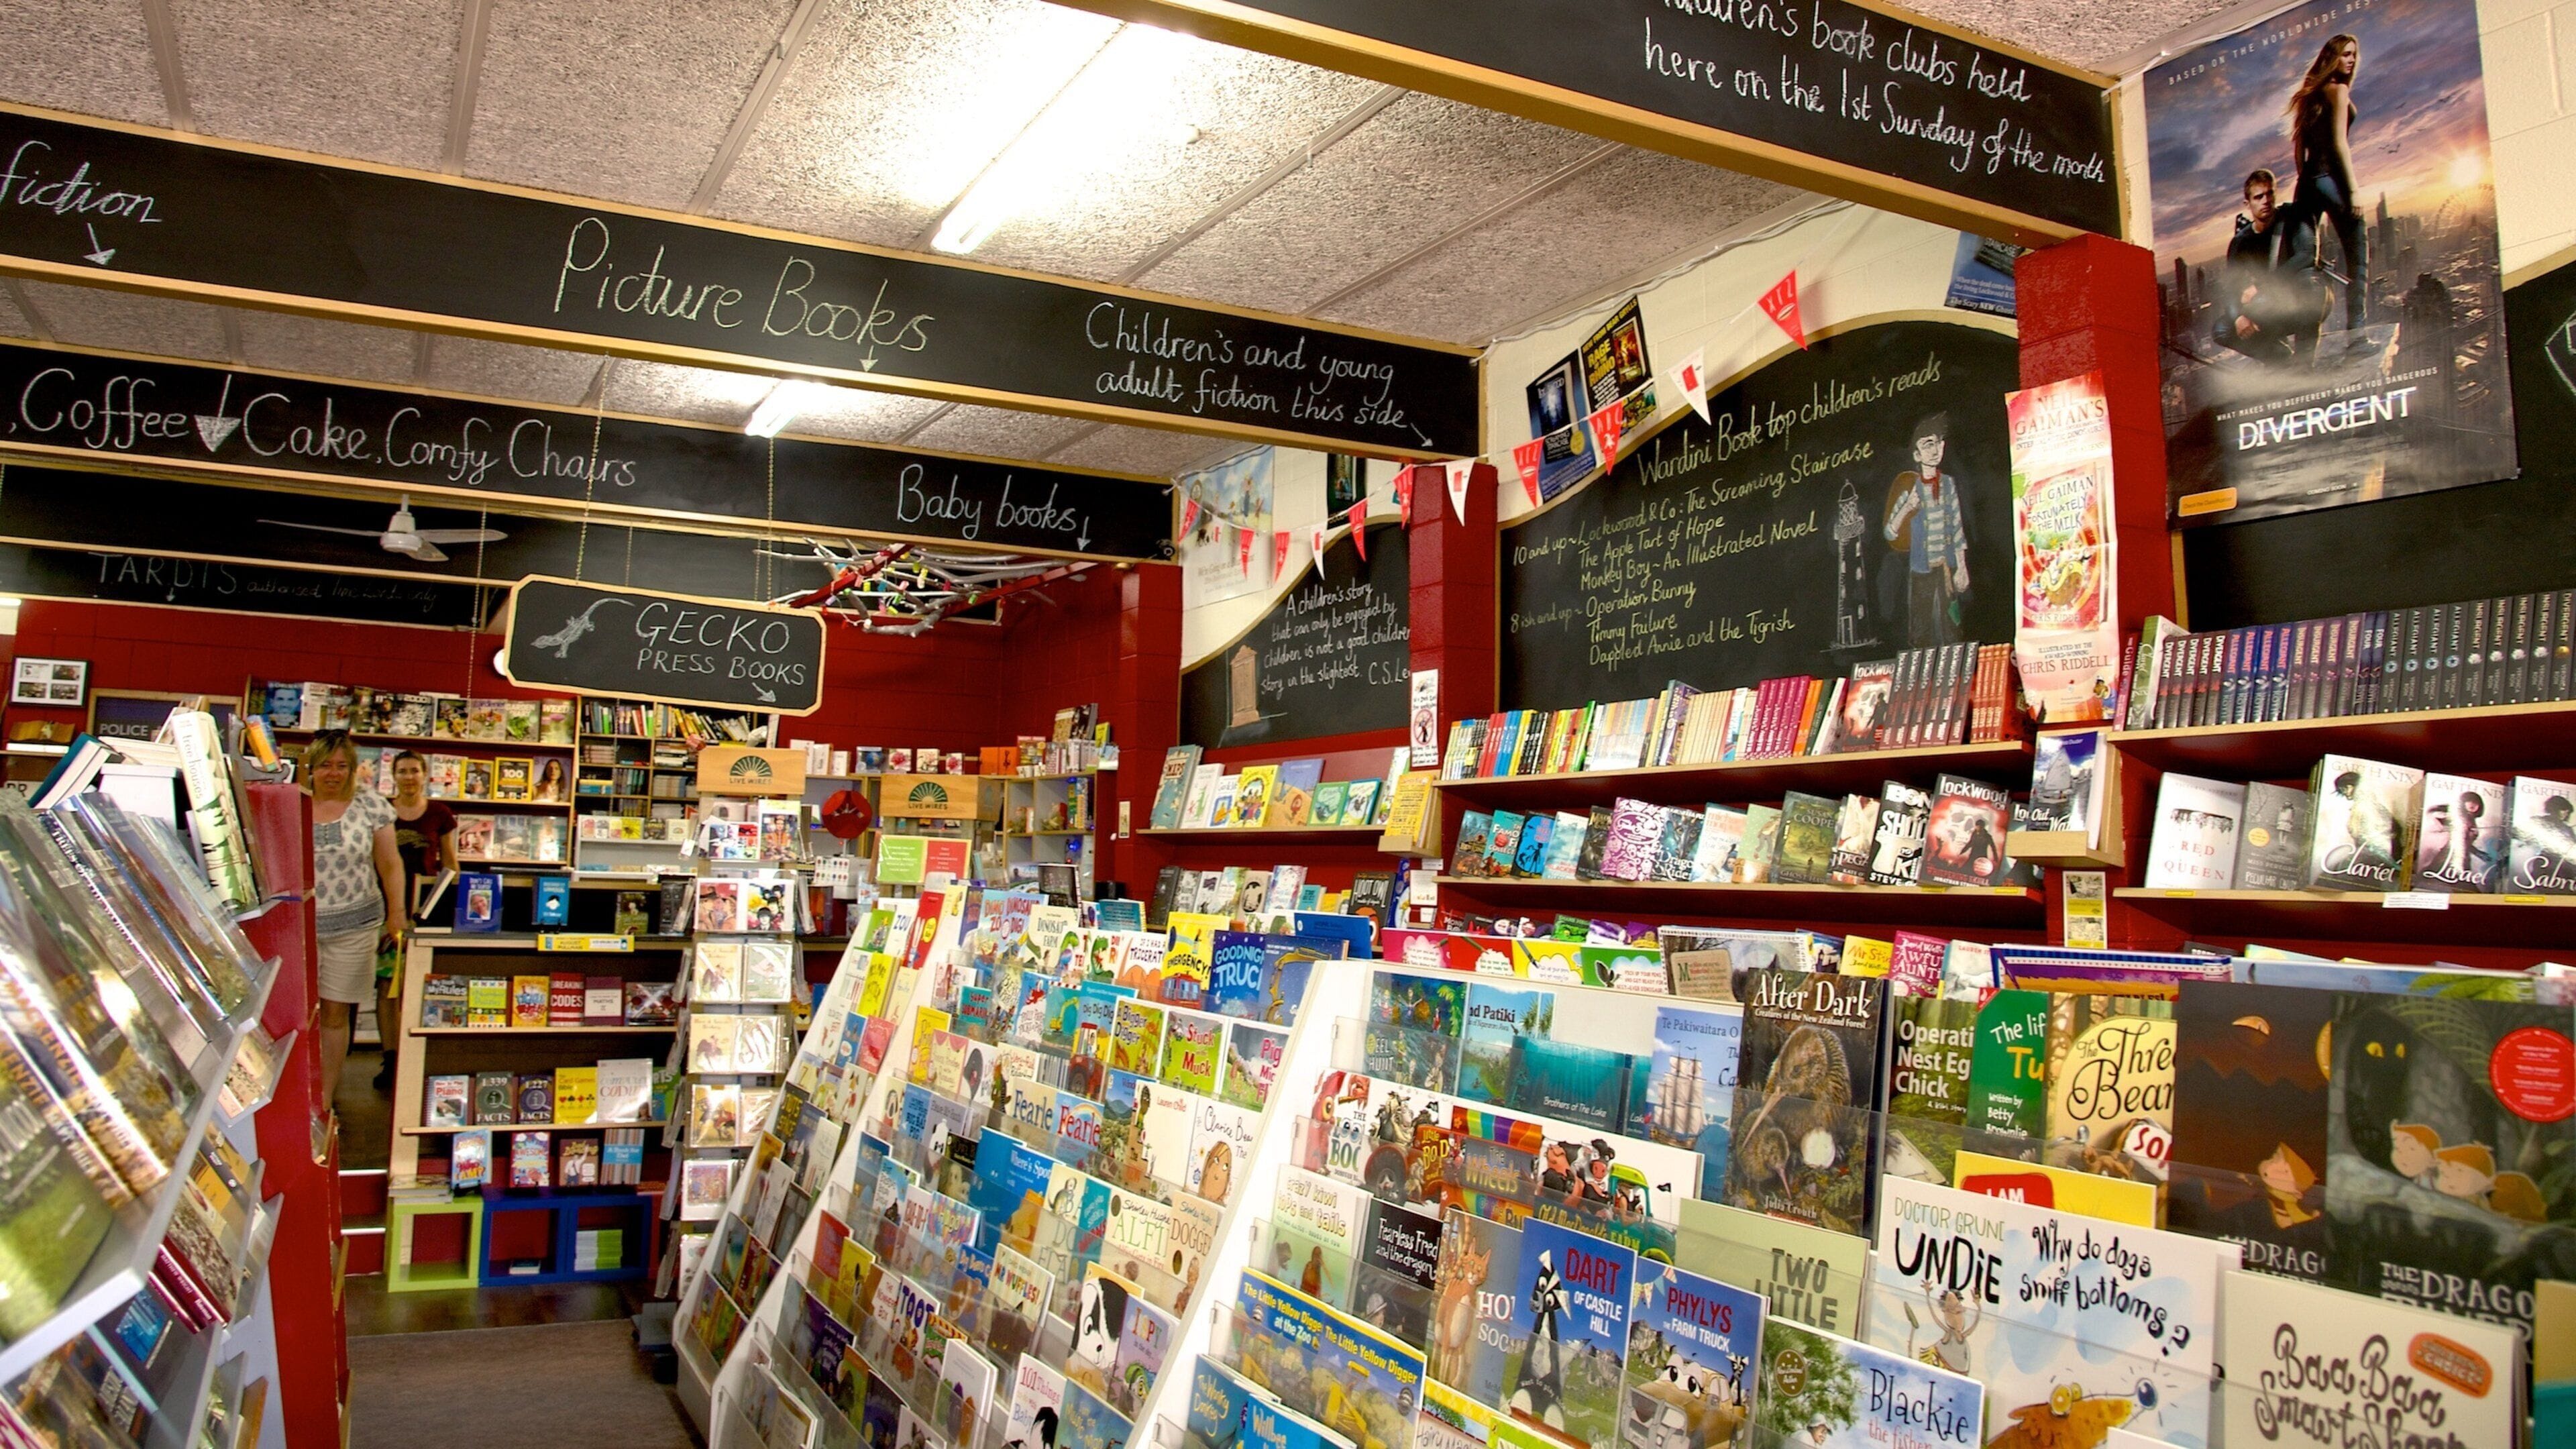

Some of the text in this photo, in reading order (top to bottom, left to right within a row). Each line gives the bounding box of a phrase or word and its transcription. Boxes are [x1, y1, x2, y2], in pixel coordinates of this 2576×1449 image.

[1811, 3, 1876, 62] book
[1887, 28, 1958, 86] clubs
[1967, 51, 2031, 103] held
[2168, 0, 2379, 86] BASED ON THE WORLDWIDE BES
[1645, 15, 2106, 183] here on the 1st Sunday of the month
[553, 217, 935, 351] Picture Books
[1085, 301, 1394, 405] Children's and young
[1095, 360, 1410, 429] adult fiction this side
[2216, 366, 2438, 421] WHAT MAKES YOU DIFFERENT MAKES YOU DANGEROUS
[21, 368, 636, 490] Coffee Cake, Comfy Chairs
[1637, 429, 1713, 486] Wardini
[1717, 405, 1765, 463] Book
[1766, 402, 1798, 450] top
[1801, 378, 1884, 427] children's
[1888, 351, 1942, 397] reads
[2015, 399, 2104, 435] GAIMAN'S
[2238, 386, 2417, 451] DIVERGENT
[897, 463, 1077, 539] Baby books
[1513, 546, 1526, 567] 10
[1527, 540, 1549, 559] and
[1578, 506, 1646, 547] Lockwood
[1649, 502, 1657, 521] &
[1685, 486, 1706, 514] The
[1710, 470, 1786, 506] Screaming
[1790, 440, 1874, 486] Staircase
[2022, 474, 2094, 508] NEIL GAIMAN
[1578, 515, 1726, 570] The Apple Tart of Hope
[1580, 510, 1819, 591] Monkey Boy An Illustrated Novel
[1285, 578, 1374, 618] A children's story
[635, 602, 790, 653] GECKO
[1272, 593, 1398, 642] that can only be enjoyed by
[1587, 608, 1678, 645] Timmy Failure
[1589, 608, 1796, 672] Dappled Annie and the Tigrish
[2227, 634, 2241, 674] ALLEGIANT
[2242, 631, 2256, 672] ALLEGIANT
[2294, 627, 2307, 665] INSURGENT
[2311, 625, 2324, 663] INSURGENT
[2363, 629, 2373, 649] FOUR
[2375, 629, 2385, 649] FOUR
[637, 648, 807, 686] PRESS BOOKS
[2021, 655, 2112, 674] CHRIS RIDDELL
[2161, 641, 2174, 678] DIVERGENT
[2174, 640, 2187, 677] DIVERGENT
[100, 723, 148, 737] POLICE
[503, 769, 523, 777] 100
[729, 777, 772, 786] LIVE WIRES
[2031, 808, 2050, 821] Out
[2181, 841, 2215, 857] RED
[2320, 843, 2402, 883] Clariel
[2422, 845, 2498, 887] Lirael
[1869, 872, 1901, 886] STEVE
[2164, 859, 2225, 881] QUEEN
[1168, 954, 1211, 979] EMERGENCY!
[550, 995, 583, 1007] CODES
[1752, 973, 1809, 1011] After
[1815, 981, 1872, 1019] Dark
[1187, 1024, 1214, 1046] Stuck
[1182, 1051, 1212, 1077] Muck
[1897, 1045, 1971, 1081] Nest Eg
[436, 1087, 463, 1096] Piano
[1895, 1071, 1949, 1099] Chick
[476, 1112, 511, 1123] FACTS
[520, 1112, 550, 1121] FACTS
[1014, 1090, 1053, 1130] Fearle
[1157, 1097, 1187, 1112] Lauren Child
[1354, 1112, 1366, 1122] THE
[1543, 1095, 1607, 1118] Brothers of The Lake
[1988, 1107, 2015, 1126] Betty
[1985, 1123, 2029, 1140] Brownlie
[1489, 1146, 1504, 1161] The
[1299, 1209, 1313, 1220] and
[1316, 1210, 1346, 1237] tails
[1378, 1218, 1438, 1258] Fearless Fred
[2032, 1218, 2151, 1278] Why do dogs
[1565, 1248, 1621, 1295] DART
[1771, 1248, 1829, 1292] TWO
[1244, 1283, 1322, 1333] The Little Yellow Digge
[1574, 1291, 1622, 1322] OF CASTLE
[1666, 1286, 1733, 1333] PHYLYS
[1755, 1277, 1838, 1330] LITTLE
[1275, 1316, 1311, 1344] at the Zoo
[1590, 1315, 1610, 1338] HILL
[1662, 1321, 1730, 1353] THE FARM TRUCK
[1326, 1326, 1418, 1386] The Little Yellow Digger
[1020, 1366, 1061, 1405] 101 Things
[2274, 1323, 2355, 1395] Baa
[2359, 1334, 2446, 1428] Baa
[1870, 1367, 1969, 1444] Blackie
[2255, 1370, 2357, 1449] Smart
